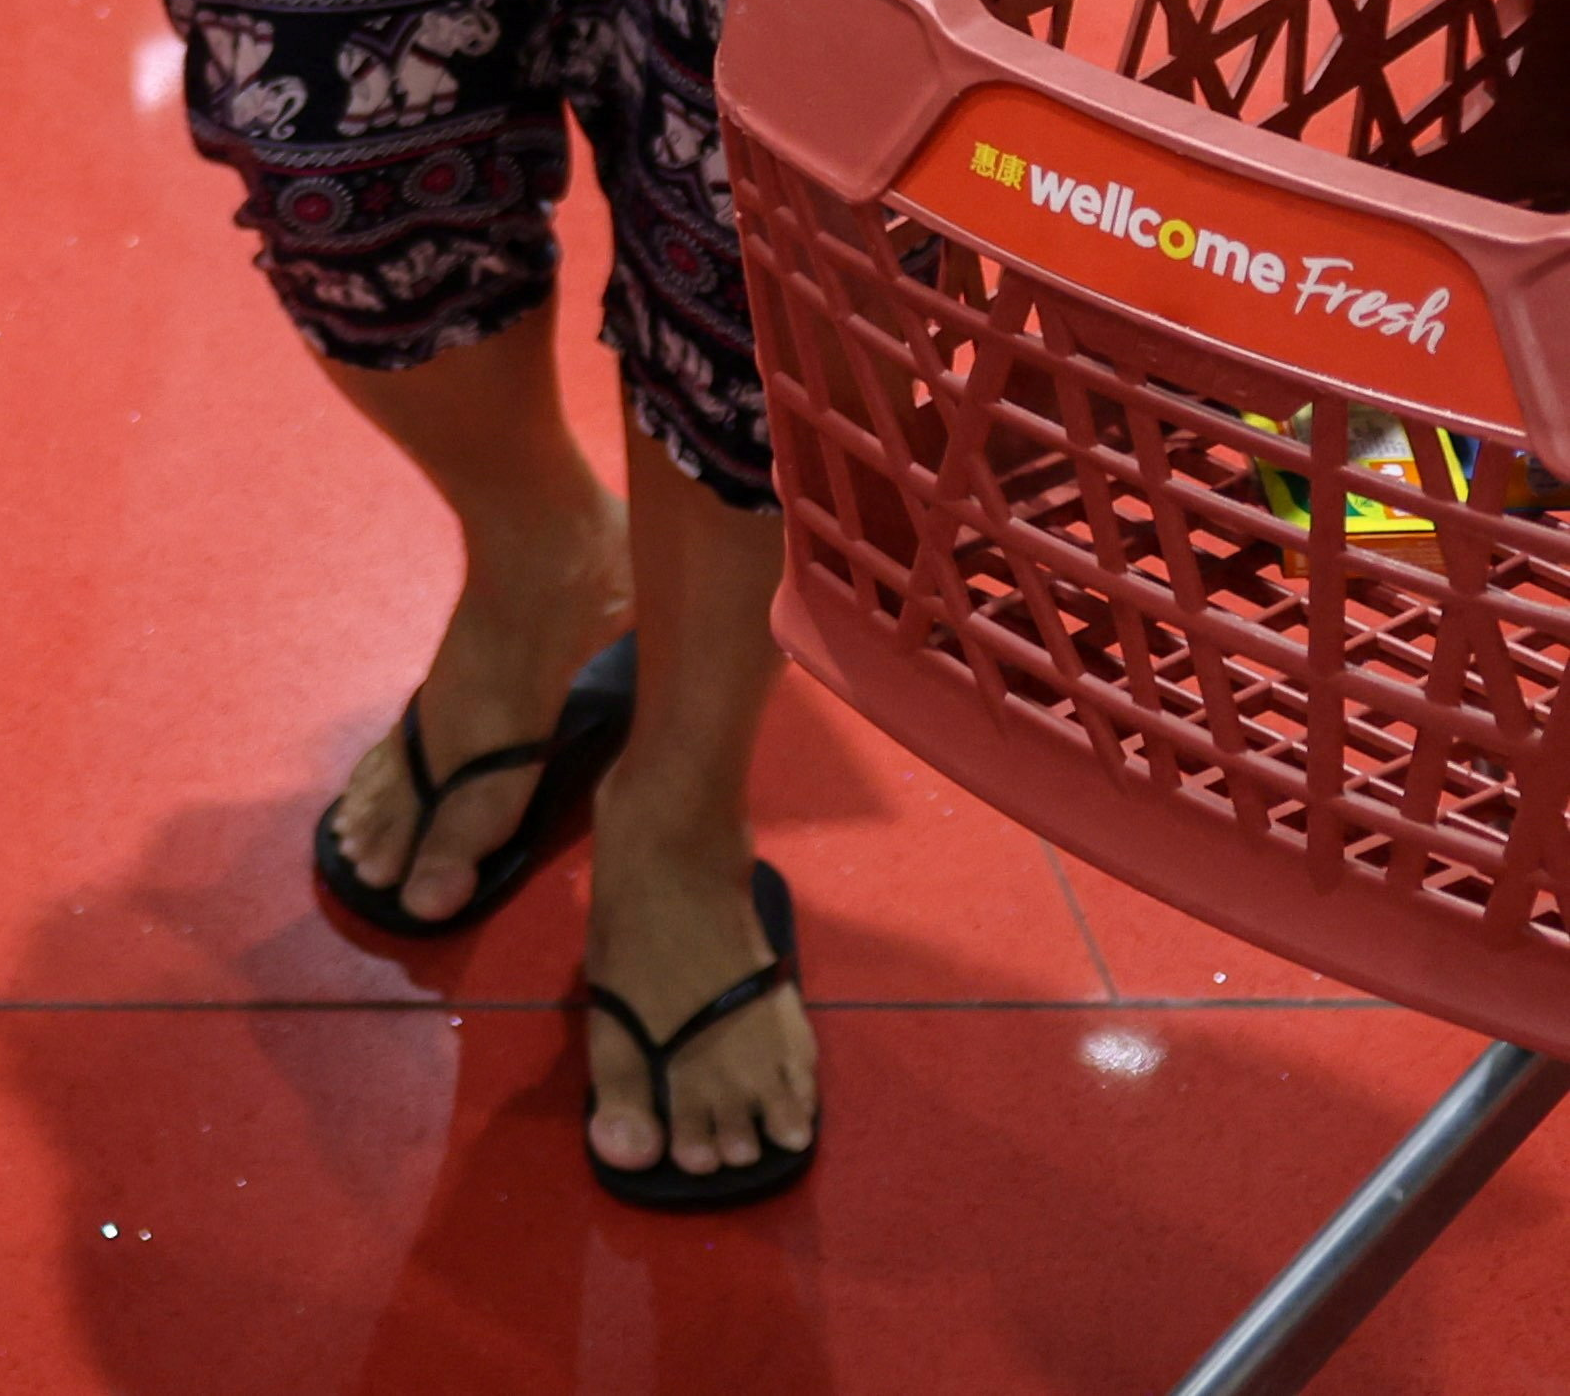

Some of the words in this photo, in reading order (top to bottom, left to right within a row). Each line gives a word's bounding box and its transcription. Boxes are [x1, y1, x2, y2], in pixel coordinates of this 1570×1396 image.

[967, 140, 1028, 193] 惠康
[1028, 162, 1288, 296] wellcome
[1294, 253, 1452, 356] Fresh
